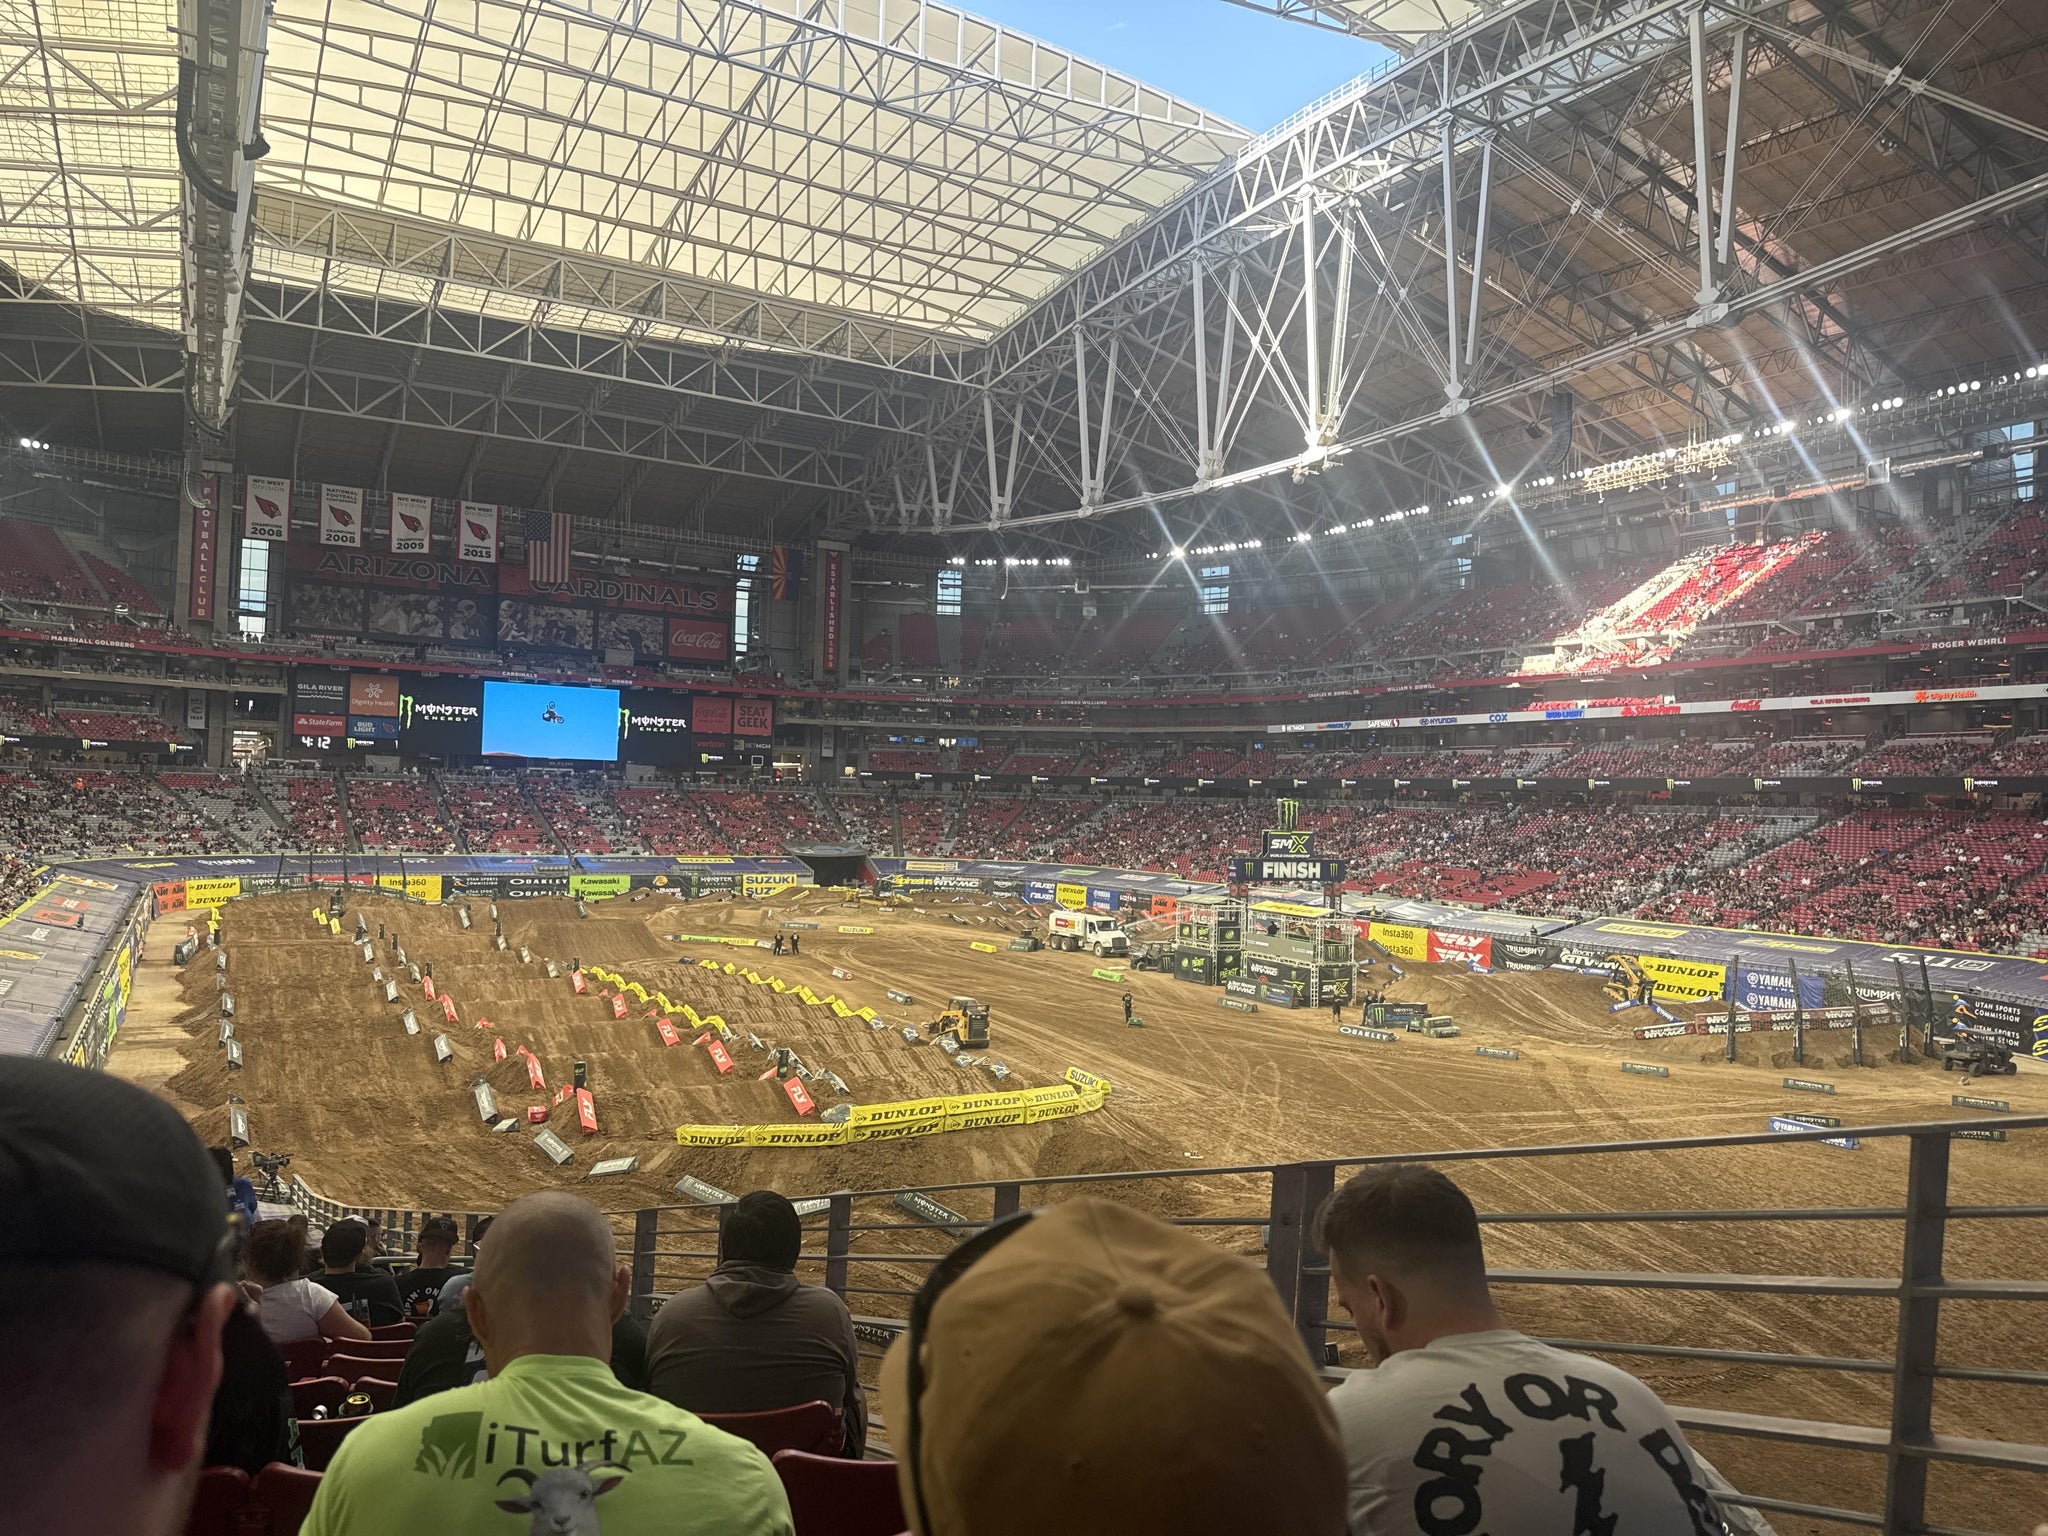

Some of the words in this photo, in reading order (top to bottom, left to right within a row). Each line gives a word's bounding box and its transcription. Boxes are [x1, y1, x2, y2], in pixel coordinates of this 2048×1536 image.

[326, 488, 359, 497] NATIONAL
[326, 493, 358, 501] FOOTBALL
[251, 527, 283, 538] 2008
[325, 533, 357, 544] 2008
[396, 542, 425, 551] 2009
[463, 549, 492, 559] 2015
[318, 552, 490, 587] ARIZONA
[197, 576, 207, 616] CLUB
[530, 576, 720, 611] CARDINALS
[51, 635, 93, 645] MARSHALL
[95, 639, 135, 648] GOLDBERG
[672, 628, 722, 650] Coca-Cola
[1931, 641, 1965, 650] ROGER
[1967, 637, 2006, 647] WEHRLI
[297, 683, 317, 691] GILA
[351, 699, 373, 707] Dignity
[415, 703, 479, 717] MONSTER
[740, 705, 768, 716] SEAT
[631, 716, 687, 728] MONSTER
[737, 718, 768, 728] GEEK
[1367, 719, 1392, 728] SAFEWAY
[1430, 717, 1458, 725] HYUNDAI
[1490, 713, 1508, 723] COX
[301, 736, 331, 750] 4:12
[1271, 835, 1310, 855] SMX
[1263, 860, 1321, 882] FINISH
[251, 877, 290, 888] MONSER
[389, 877, 427, 888] Insa360
[701, 875, 733, 883] MONSTER
[745, 875, 796, 885] SUZUKI
[1030, 881, 1056, 890] FALKEN
[195, 881, 237, 892] DUNLOP
[195, 895, 230, 905] DUNLO
[1030, 892, 1055, 901] FALKEN
[843, 926, 868, 934] SUZUKI
[1382, 927, 1414, 940] Insta360
[1433, 931, 1486, 947] FLY
[1505, 944, 1538, 957] TRIUMPH
[1505, 961, 1536, 971] TRIUMPH
[1655, 963, 1720, 979] DUNLOP
[1758, 973, 1794, 988] YAMAH
[1655, 983, 1719, 997] DUNLOP
[1975, 1001, 1994, 1010] UTAH
[1995, 1003, 2021, 1015] SPORTS
[1974, 1009, 2020, 1024] COMMISSION
[662, 1024, 676, 1042] FLY
[1351, 1029, 1389, 1042] OAKLEY
[713, 1048, 730, 1067] FLY
[789, 1087, 807, 1107] FLY
[1034, 1089, 1077, 1108] DUNLOP
[582, 1096, 597, 1122] FLY
[962, 1096, 1022, 1112] DUNLOP
[870, 1104, 945, 1123] DUNLOP
[1036, 1104, 1080, 1121] DUNLOP
[961, 1112, 1022, 1130] DUNLOP
[868, 1118, 940, 1140] DUNLOP
[689, 1134, 747, 1147] DUNLOP
[768, 1131, 842, 1146] DUNLOP
[693, 1181, 725, 1201] MONSTER
[911, 1195, 950, 1219] MONSTER
[486, 1432, 694, 1468] iTurfAZ
[1413, 1381, 1515, 1536] ORY
[1503, 1372, 1627, 1434] OR
